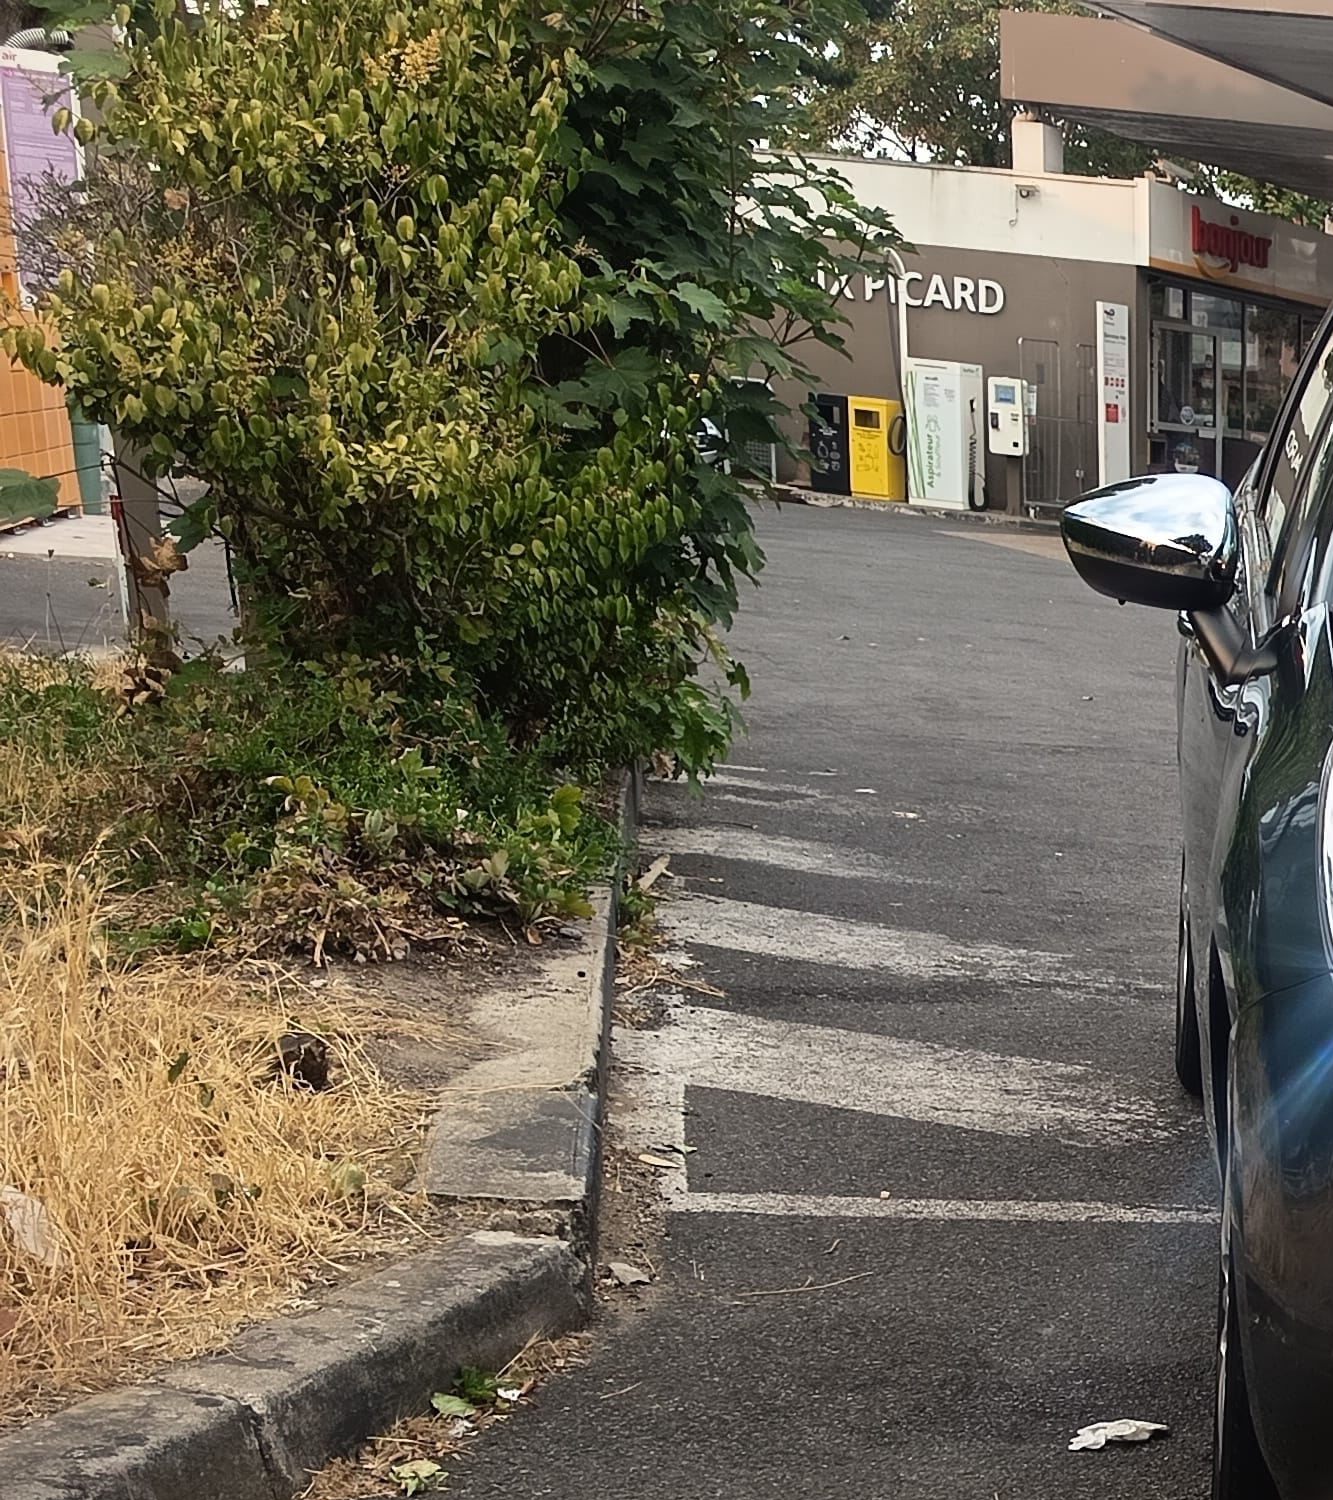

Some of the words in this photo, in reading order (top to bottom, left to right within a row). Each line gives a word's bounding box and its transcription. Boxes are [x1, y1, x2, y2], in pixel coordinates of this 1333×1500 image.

[1192, 205, 1272, 273] bonjour
[865, 271, 1005, 315] PICARD
[925, 433, 936, 489] Aspirateur
